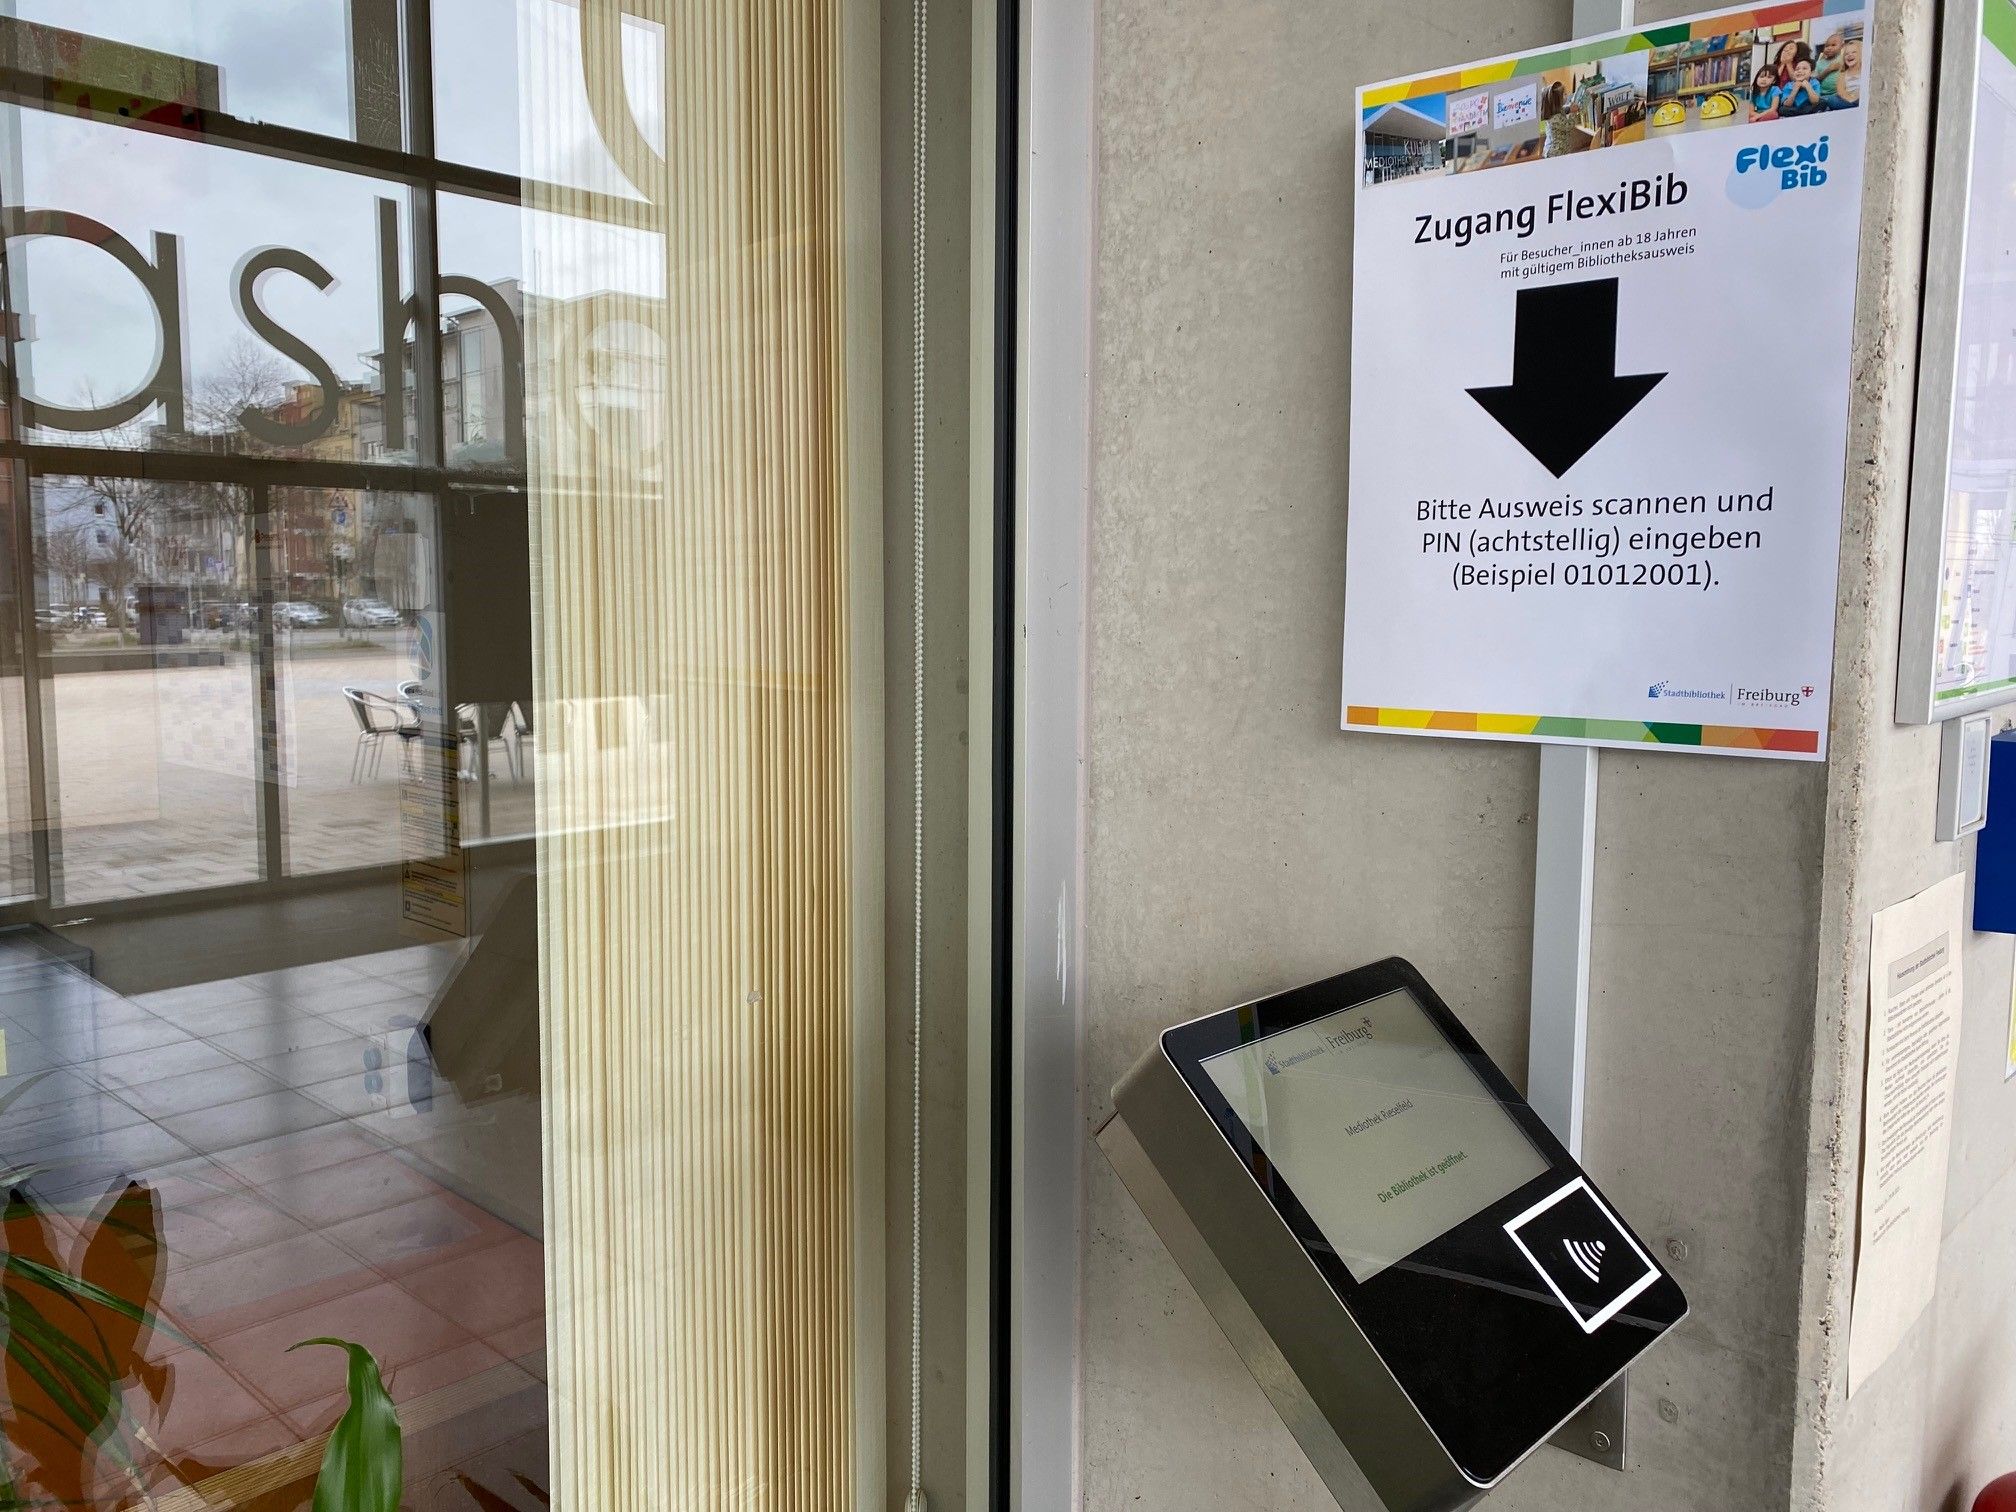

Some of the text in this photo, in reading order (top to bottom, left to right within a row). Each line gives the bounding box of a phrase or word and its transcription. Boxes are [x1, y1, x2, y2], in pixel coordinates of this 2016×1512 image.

[1736, 135, 1829, 174] Flexi
[1781, 164, 1828, 190] Bib
[1414, 172, 1688, 247] Zugang FlexiBib
[1500, 226, 1697, 264] Für Besucher_innen ab 18 Jahren
[1500, 242, 1695, 280] mit gültigem Bibliotheksausweis
[1417, 486, 1774, 521] Bitte Ausweis scannen und
[1422, 524, 1761, 558] PIN (achtstellig) eingeben
[1453, 559, 1720, 592] (Beispiel 01012001).
[1663, 688, 1726, 700] Stadtbibliothek
[1737, 687, 1800, 707] Freiburg
[1325, 1026, 1374, 1050] Freiburg
[1344, 1098, 1414, 1137] Mediothek Rieselfeld
[1377, 1190, 1394, 1204] Die
[1391, 1170, 1430, 1197] Bibliothek
[1425, 1164, 1438, 1178] ist
